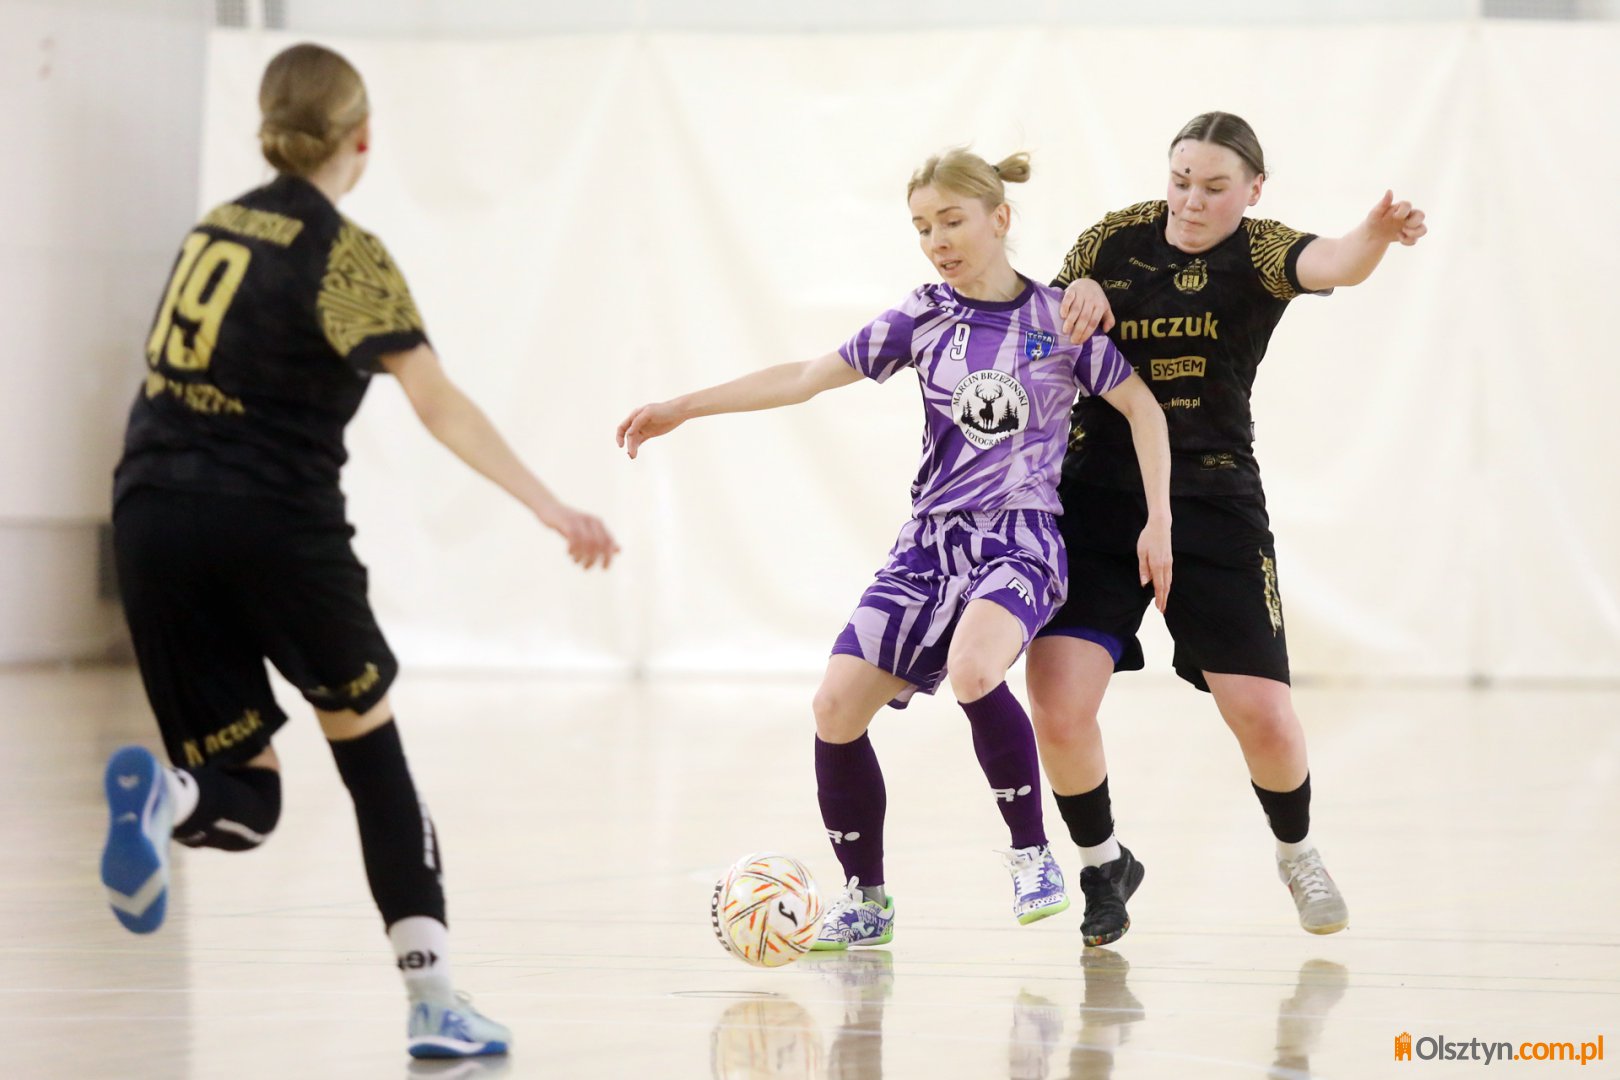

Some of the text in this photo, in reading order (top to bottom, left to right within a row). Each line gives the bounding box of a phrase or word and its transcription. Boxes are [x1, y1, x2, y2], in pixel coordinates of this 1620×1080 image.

[147, 232, 251, 368] 19
[950, 322, 971, 361] 9
[1152, 359, 1204, 378] SYSTEM
[952, 374, 979, 406] MARCIN
